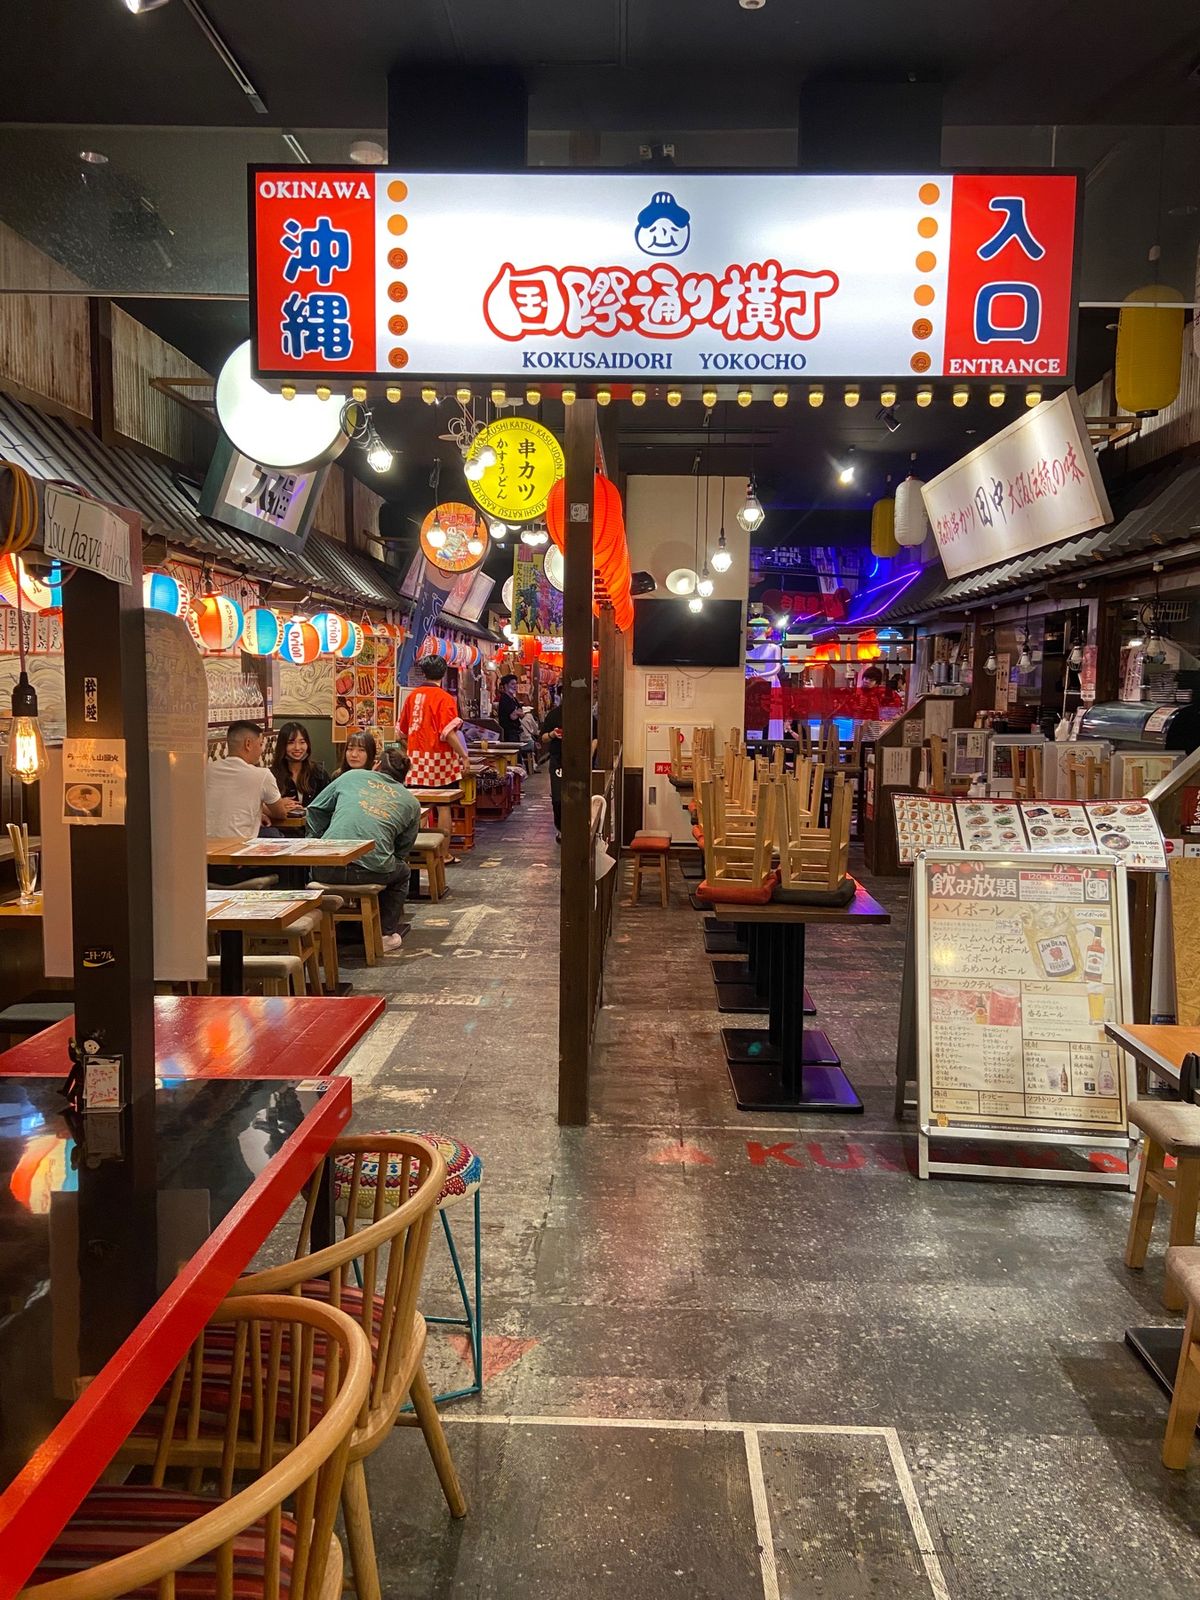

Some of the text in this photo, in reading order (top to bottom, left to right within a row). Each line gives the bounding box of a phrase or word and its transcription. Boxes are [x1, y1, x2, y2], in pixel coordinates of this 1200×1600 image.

[260, 181, 371, 200] OKINAWA
[973, 196, 1046, 345] 入口
[280, 216, 354, 360] 沖縄
[483, 259, 839, 342] 国際通り横丁
[522, 351, 807, 370] KOKUSAIDORI YOKOCHO
[949, 358, 1061, 374] ENTRANCE
[510, 421, 534, 431] KATSU
[497, 437, 508, 500] かすうどん
[518, 438, 536, 501] 串カツ
[67, 503, 103, 568] have
[931, 873, 1017, 898] 飲み放題
[932, 902, 1005, 917] ハイボール
[932, 932, 1025, 944] ジムビームハイボール
[1024, 982, 1051, 992] ビール
[1028, 1009, 1064, 1018] 香るエール
[1027, 1095, 1063, 1104] ソフトドリンク
